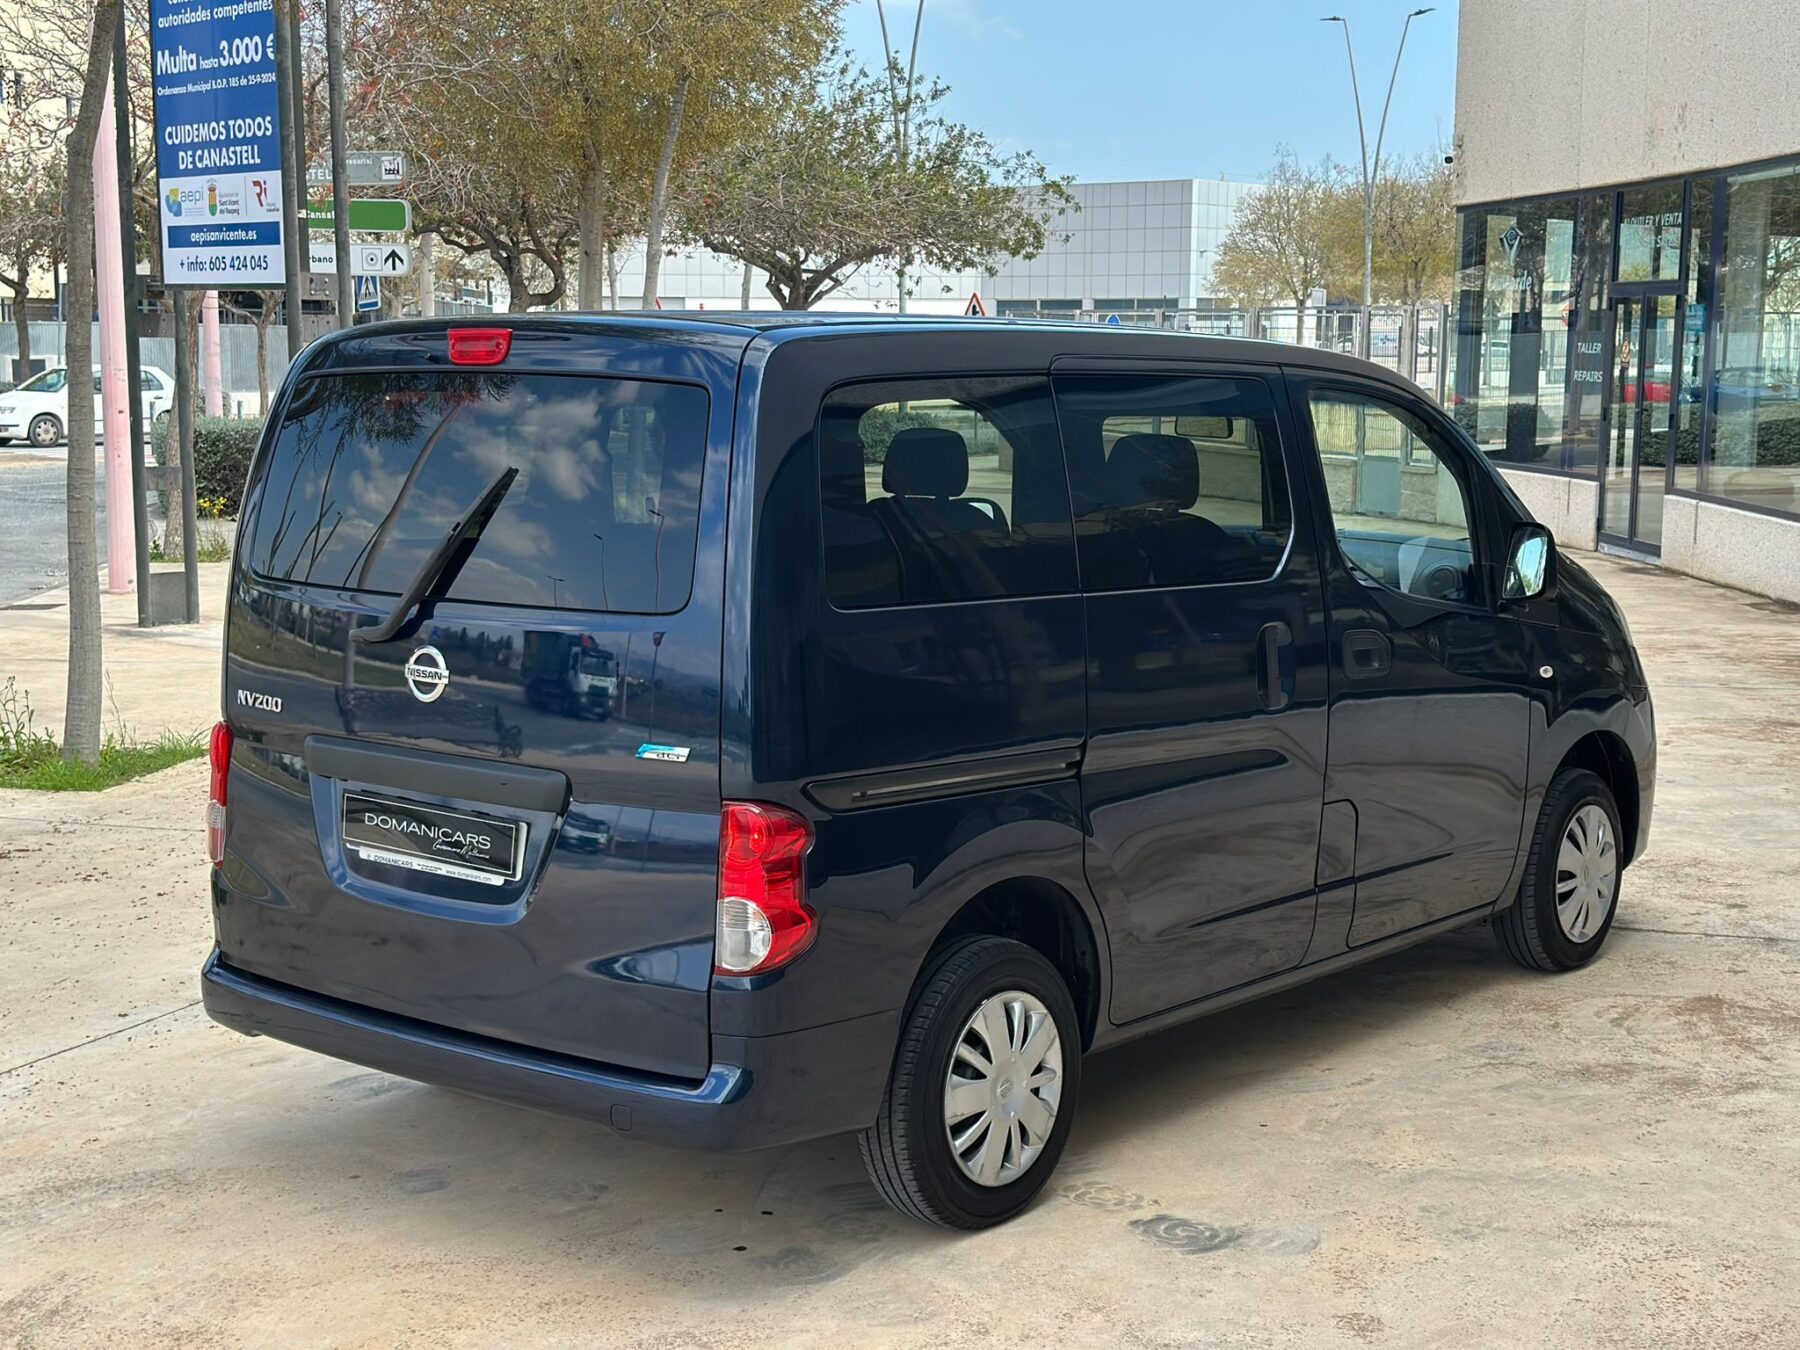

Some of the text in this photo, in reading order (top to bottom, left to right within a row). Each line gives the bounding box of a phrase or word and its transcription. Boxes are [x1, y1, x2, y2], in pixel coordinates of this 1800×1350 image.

[158, 0, 273, 28] autoridades competentes
[157, 33, 275, 75] Multa hasta 3.000 €
[157, 85, 187, 96] Ordenanza
[187, 80, 211, 93] Municipal
[240, 76, 247, 86] de
[165, 116, 273, 145] CUIDEMOS TODOS
[178, 144, 261, 169] DE CANASTELL
[180, 187, 204, 204] aepi
[1661, 212, 1682, 226] VENTA
[191, 227, 257, 244] aepisanvicente.es
[180, 255, 268, 272] + info: 605 424 045
[309, 255, 334, 263] bano
[1577, 342, 1602, 354] TALLER
[1573, 370, 1604, 383] REPAIRS
[407, 667, 443, 680] NISSAN
[237, 689, 282, 713] NV200
[365, 813, 491, 849] DOMANICARS
[374, 854, 414, 868] DOMANICARS
